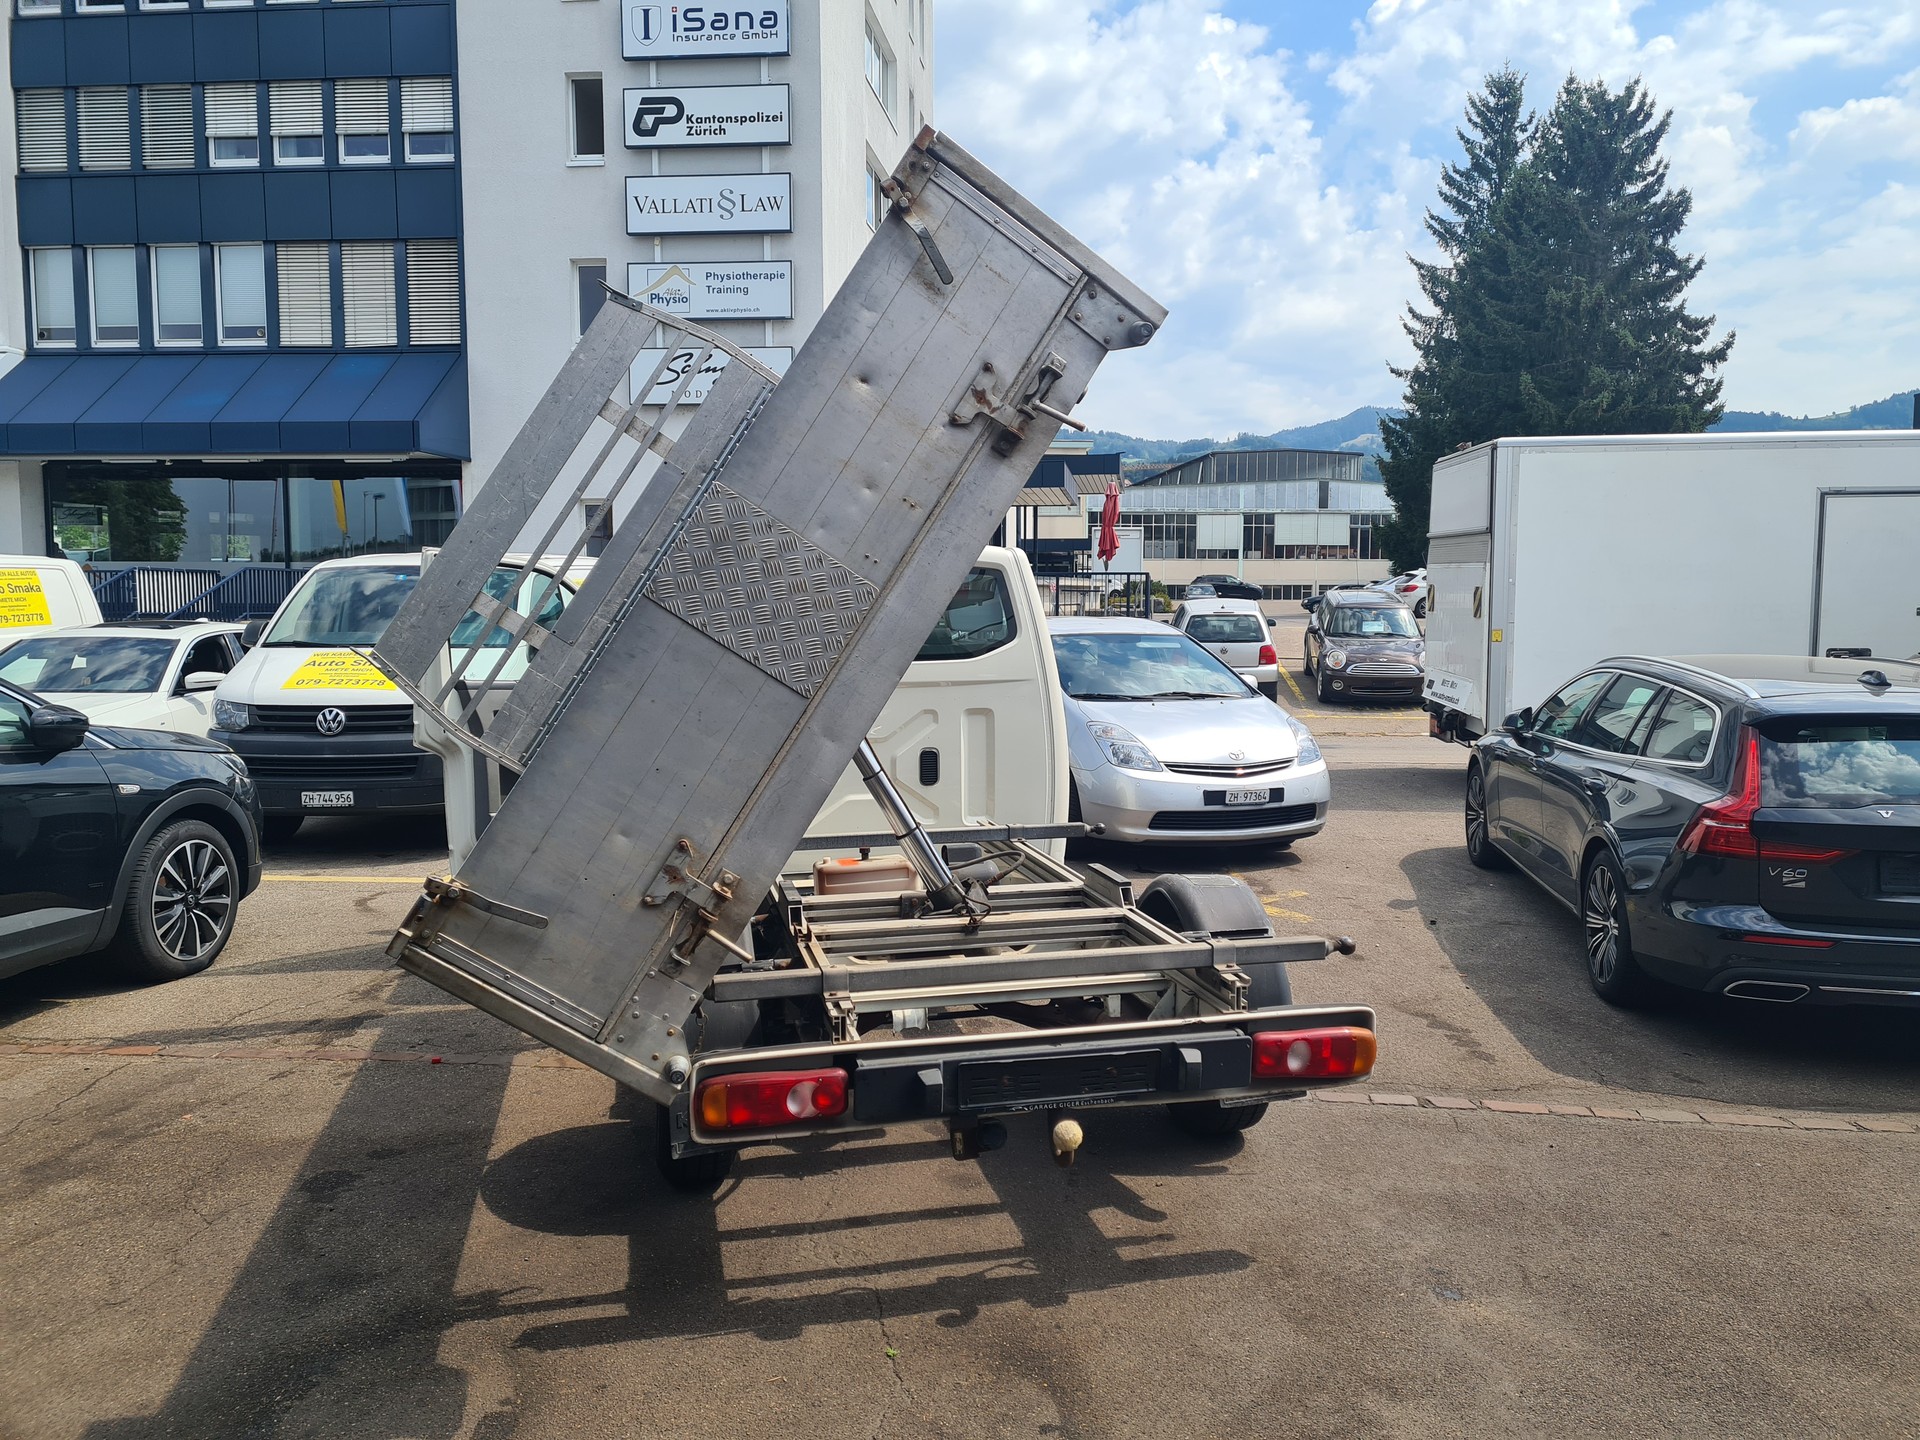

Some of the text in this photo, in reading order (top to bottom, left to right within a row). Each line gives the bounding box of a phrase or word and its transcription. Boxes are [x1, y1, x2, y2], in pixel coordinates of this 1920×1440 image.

[671, 6, 779, 33] iSana
[672, 30, 779, 43] Insurance GmbH
[685, 111, 784, 126] Kantonspolizei
[686, 125, 727, 137] Zürich
[739, 194, 785, 213] LAW
[705, 270, 786, 283] Physiotherapie
[706, 284, 749, 297] Training
[650, 292, 689, 307] Physio
[7, 582, 42, 594] Smaka
[304, 660, 346, 668] Auto
[295, 678, 387, 686] 079-7273778
[1029, 1103, 1057, 1111] GARAGE
